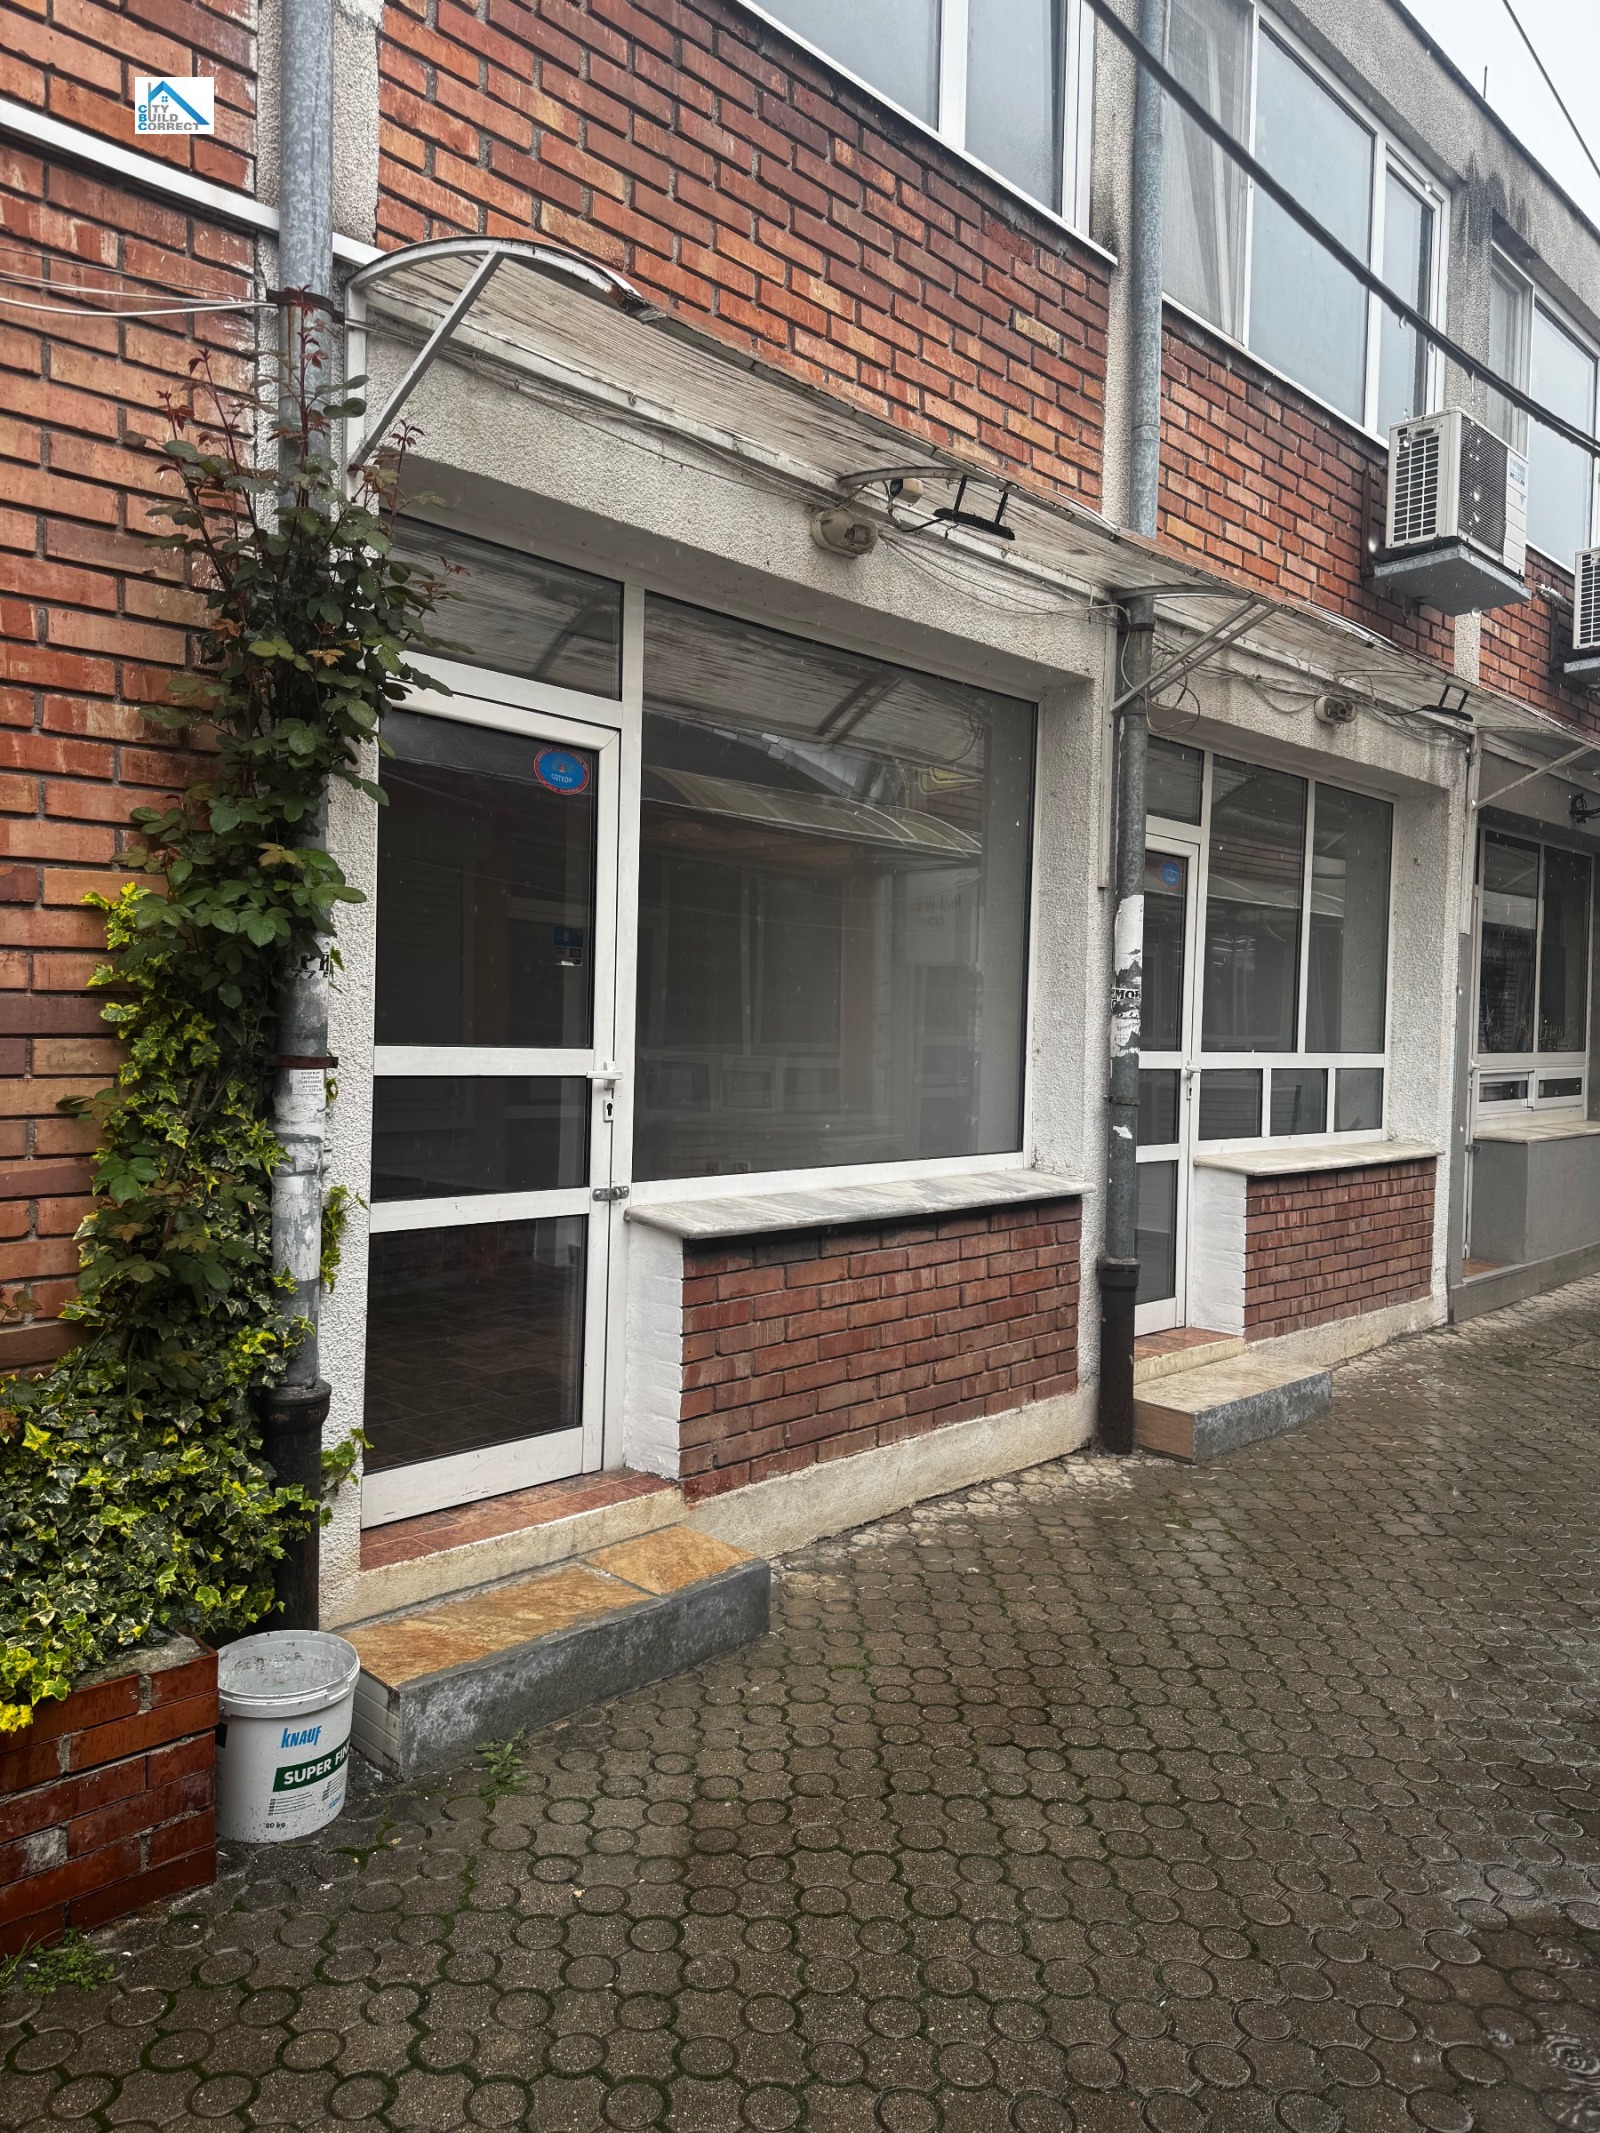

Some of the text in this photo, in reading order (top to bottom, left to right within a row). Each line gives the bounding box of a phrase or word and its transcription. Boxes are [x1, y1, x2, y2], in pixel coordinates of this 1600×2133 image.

[281, 1725, 323, 1749] KNAUF
[283, 1758, 332, 1786] SUPER
[276, 1821, 286, 1830] kg
